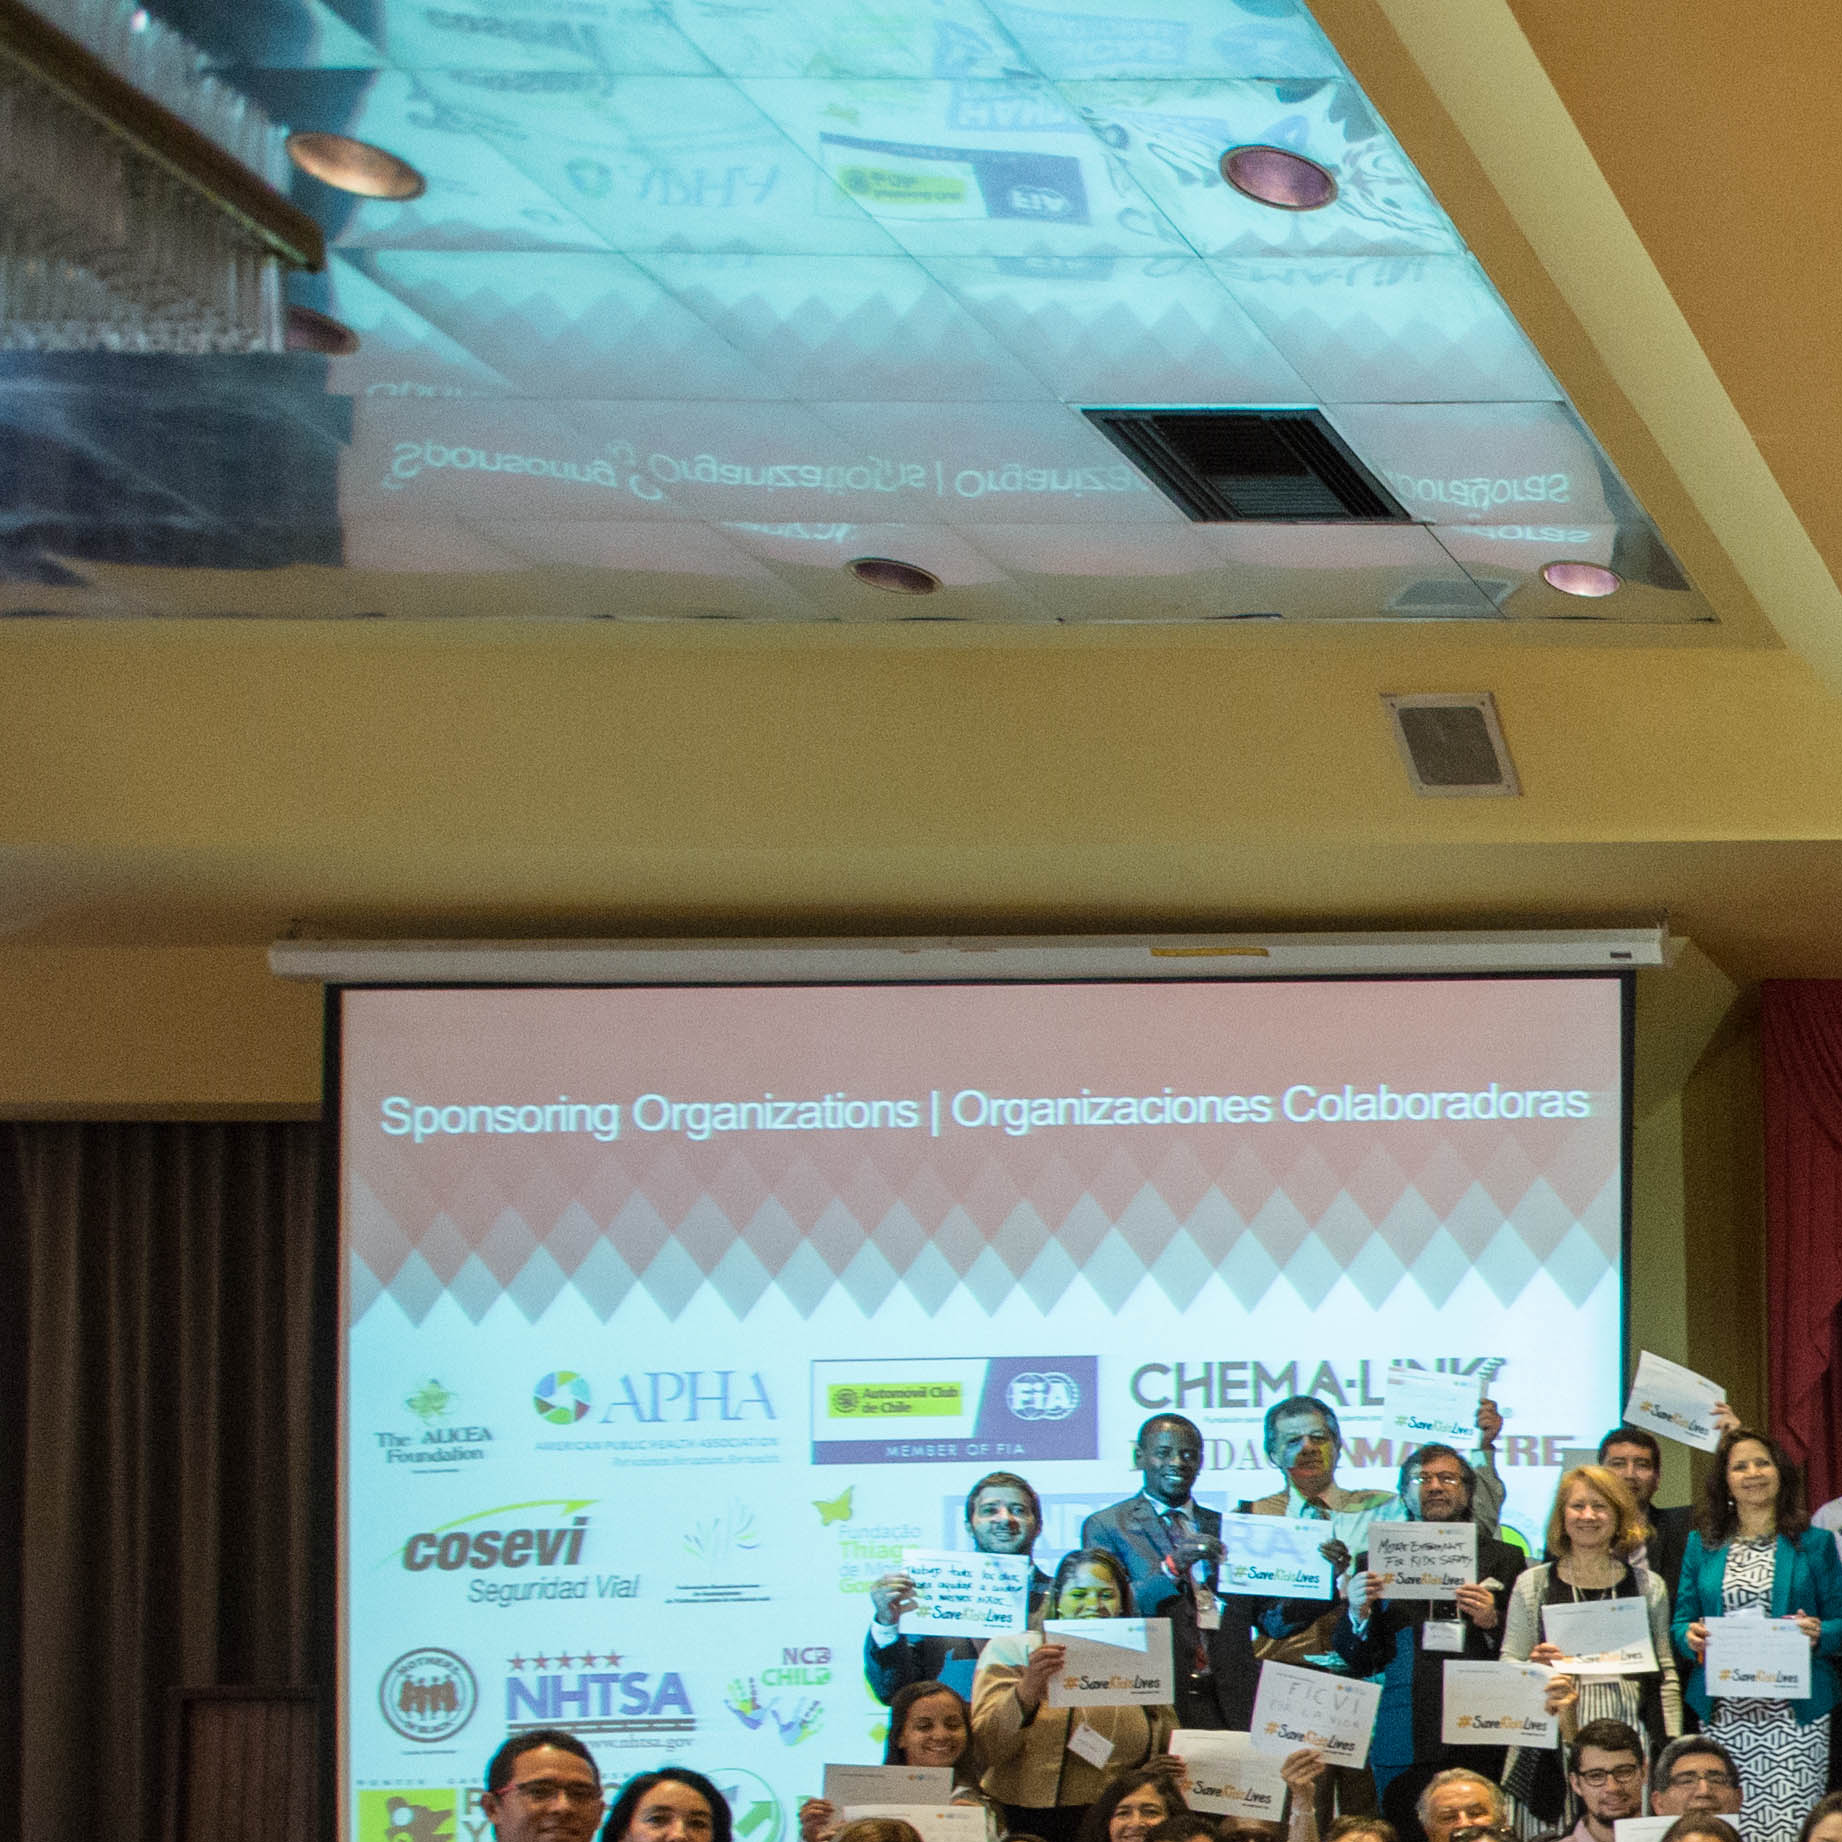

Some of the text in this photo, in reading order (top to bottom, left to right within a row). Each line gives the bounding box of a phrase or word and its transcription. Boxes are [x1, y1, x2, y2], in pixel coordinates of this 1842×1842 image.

[381, 1096, 620, 1143] Sponsoring
[632, 1092, 919, 1141] Organizations
[951, 1087, 1273, 1137] Organizaciones
[1283, 1084, 1592, 1123] Colaboradoras
[600, 1370, 778, 1424] APHA
[935, 1386, 958, 1398] Club
[863, 1401, 912, 1413] de Chile
[375, 1432, 412, 1448] The
[885, 1443, 1025, 1458] MEMBER OF FIA
[387, 1446, 483, 1465] Foundation
[403, 1516, 591, 1572] cosevi
[468, 1574, 642, 1607] Seguridad Vial
[507, 1671, 695, 1721] NHTSA
